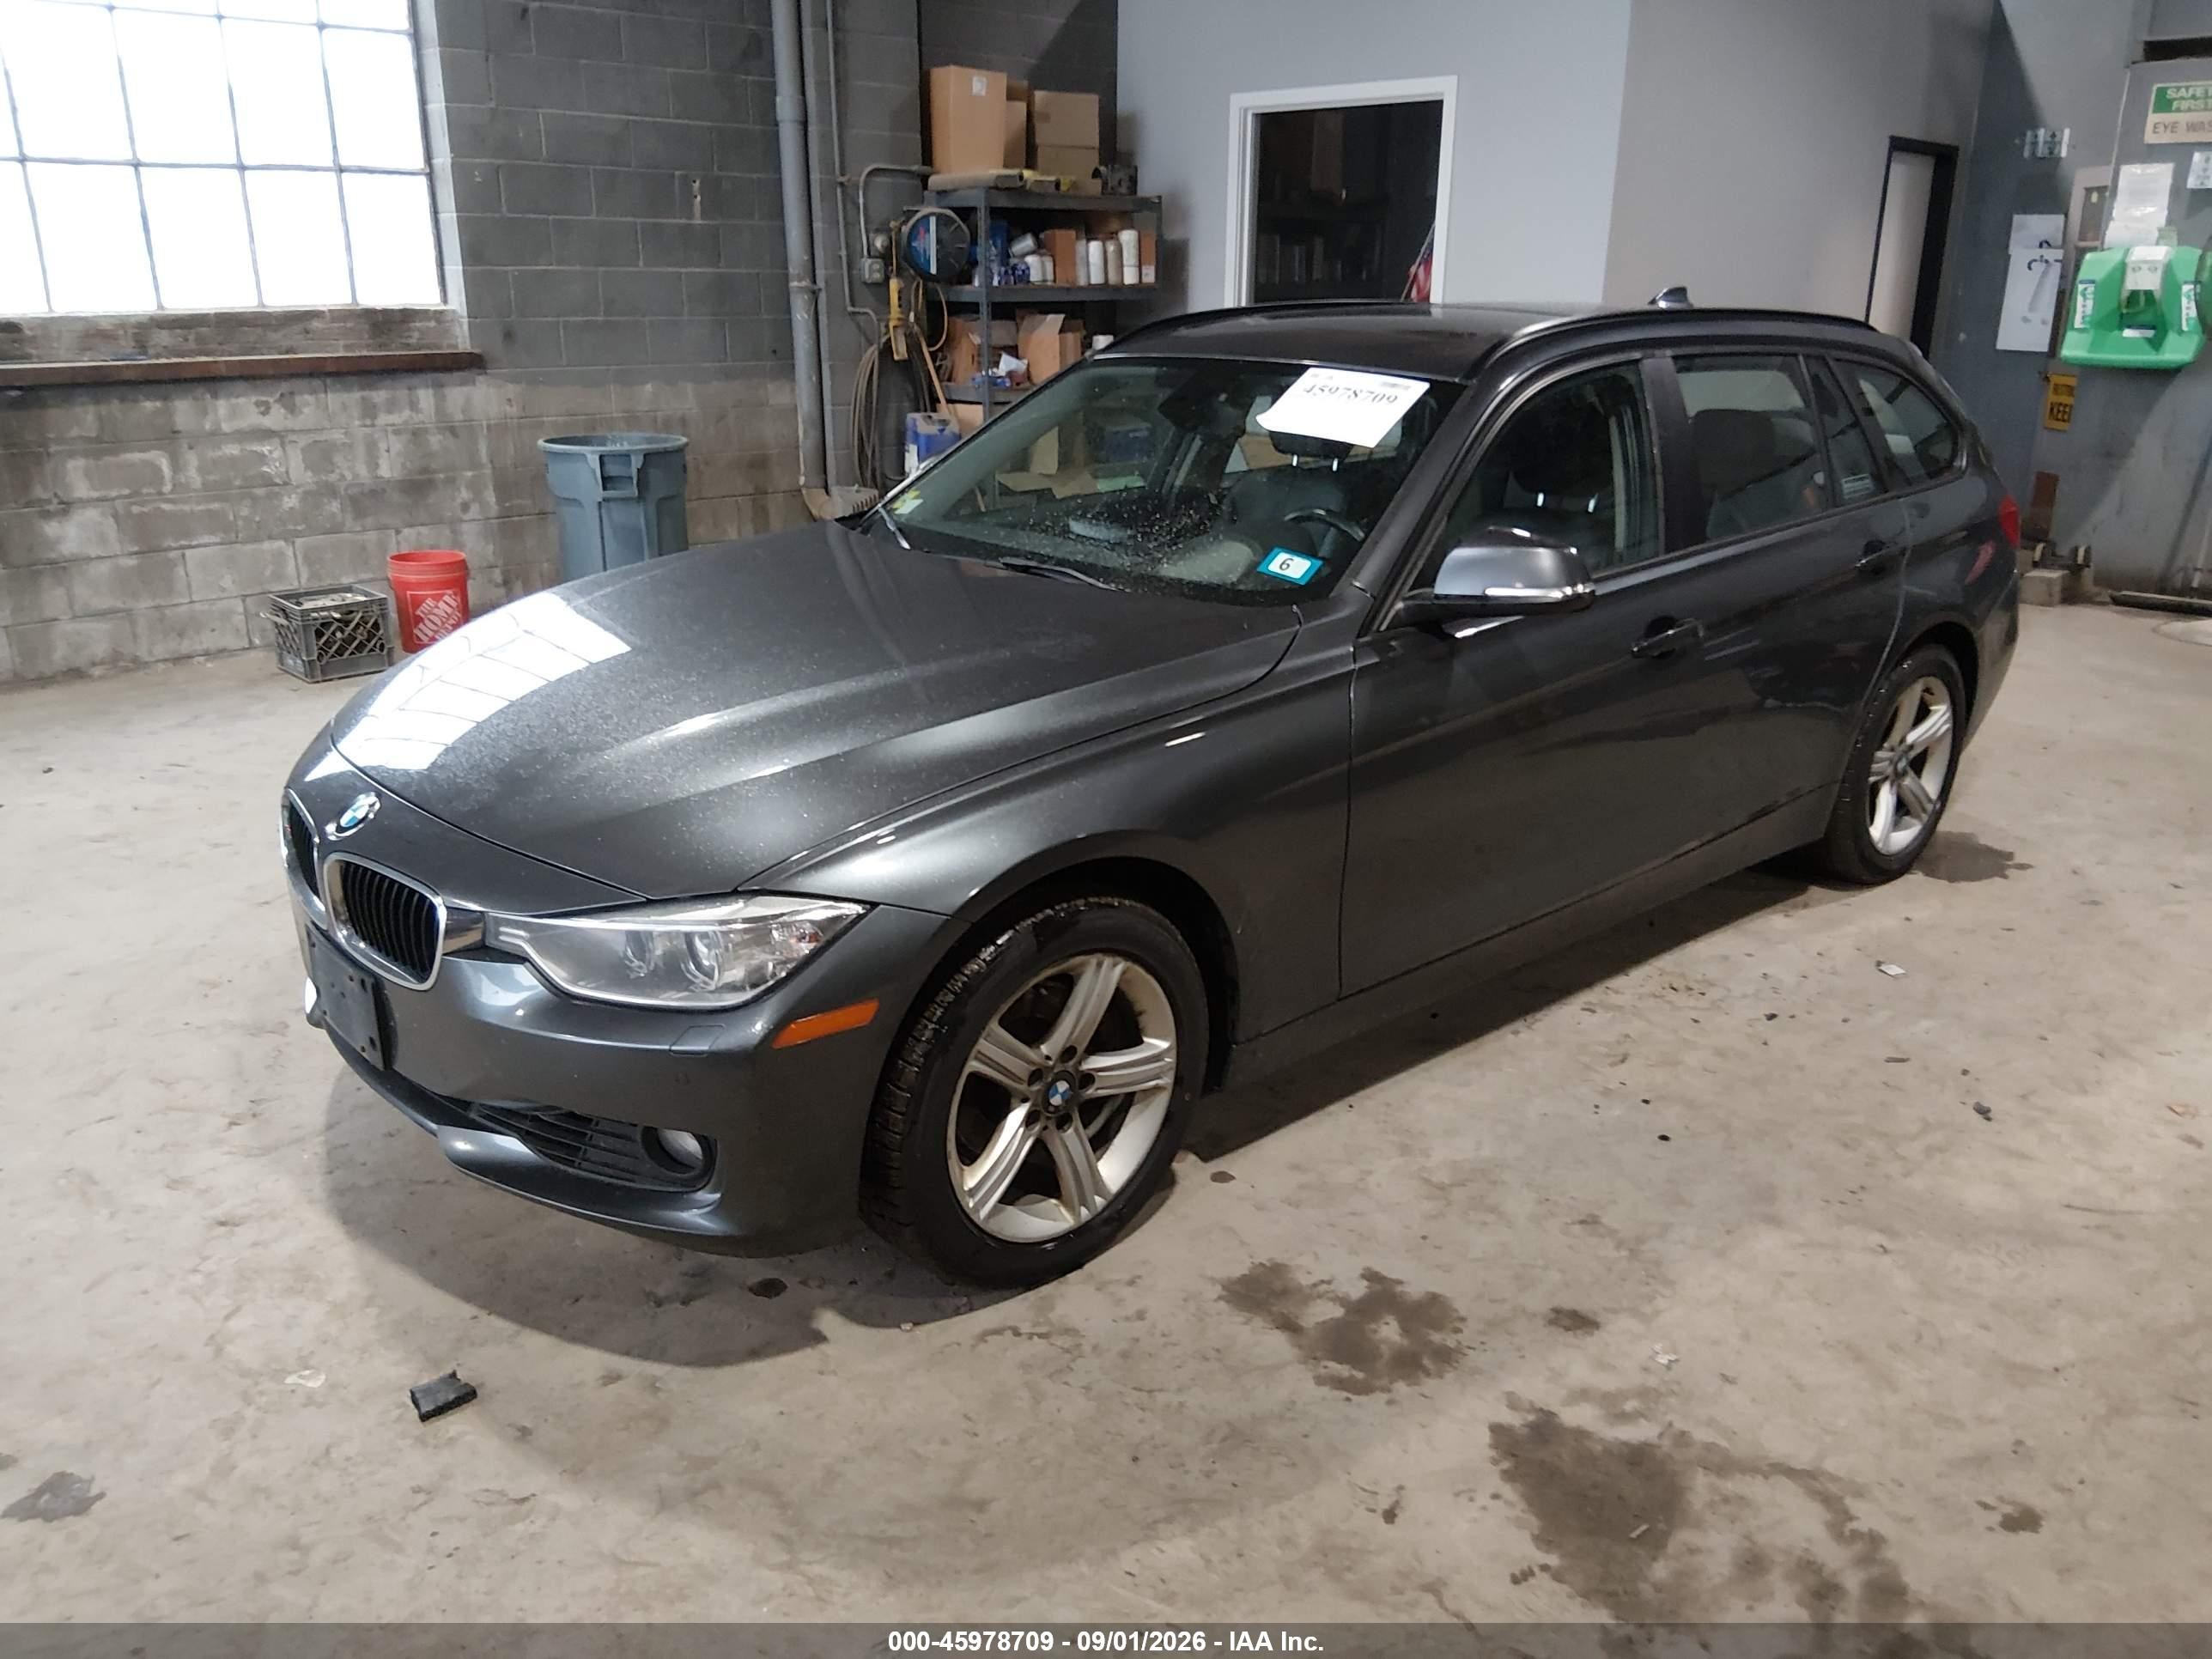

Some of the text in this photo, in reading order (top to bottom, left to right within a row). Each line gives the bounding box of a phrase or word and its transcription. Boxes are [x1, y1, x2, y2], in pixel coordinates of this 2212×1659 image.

[2152, 121, 2179, 134] EYE
[1279, 557, 1294, 571] 6
[412, 591, 460, 643] HOME
